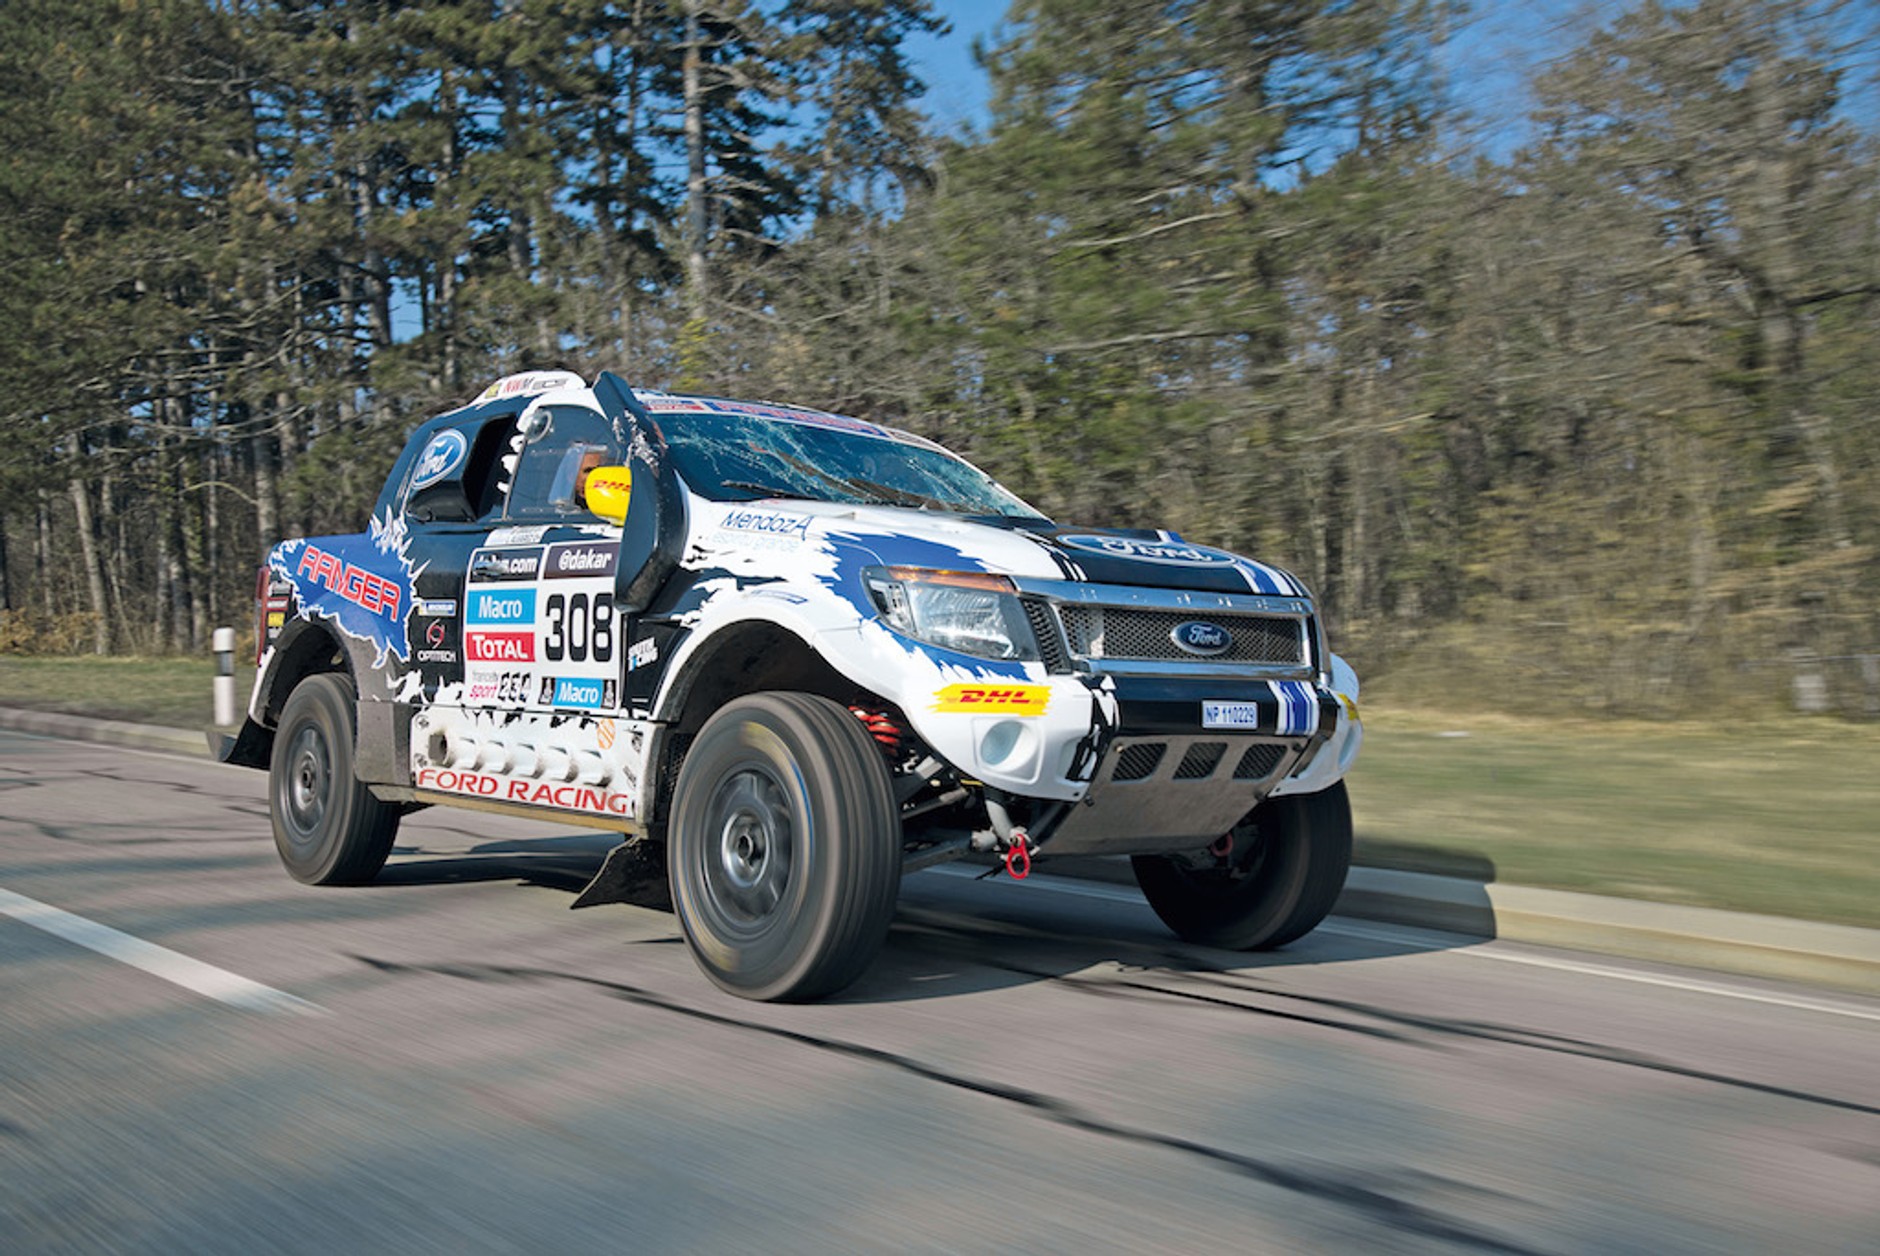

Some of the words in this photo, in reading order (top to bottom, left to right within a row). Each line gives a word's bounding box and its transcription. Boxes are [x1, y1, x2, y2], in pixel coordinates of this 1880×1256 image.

[558, 548, 613, 571] @dakar
[1095, 536, 1213, 562] Ford
[297, 544, 400, 622] RANGER
[478, 596, 523, 619] Macro
[544, 593, 614, 662] 308
[1187, 624, 1222, 646] Ford
[469, 683, 498, 700] sport
[558, 682, 599, 702] Macro
[960, 690, 1031, 703] DHL
[418, 768, 499, 795] FORD
[507, 779, 628, 814] RACING
